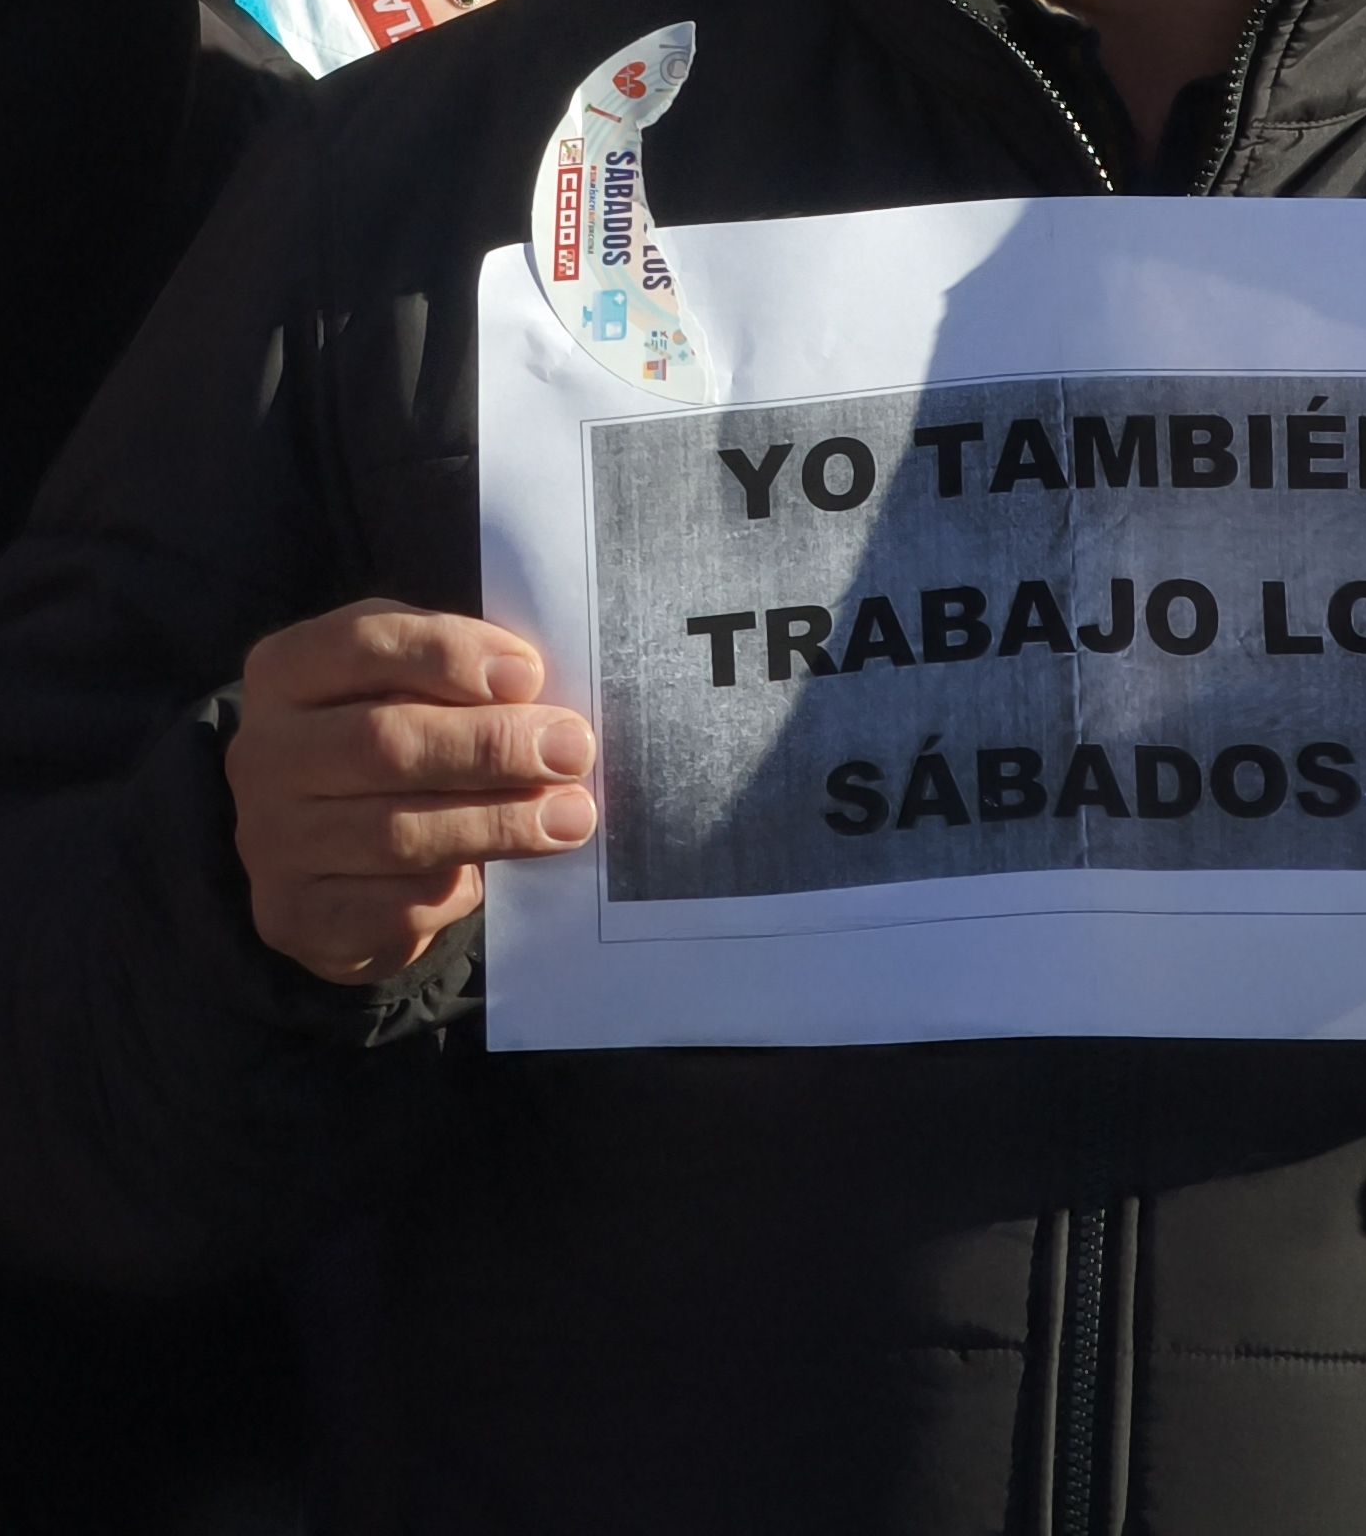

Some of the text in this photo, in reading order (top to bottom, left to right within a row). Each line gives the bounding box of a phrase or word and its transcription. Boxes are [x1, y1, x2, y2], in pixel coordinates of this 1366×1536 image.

[558, 172, 578, 246] CCOO
[602, 151, 639, 266] SÁBADOS
[717, 436, 876, 519] YO
[686, 576, 1218, 688] TRABAJO
[825, 734, 1362, 836] SÁBADOS
